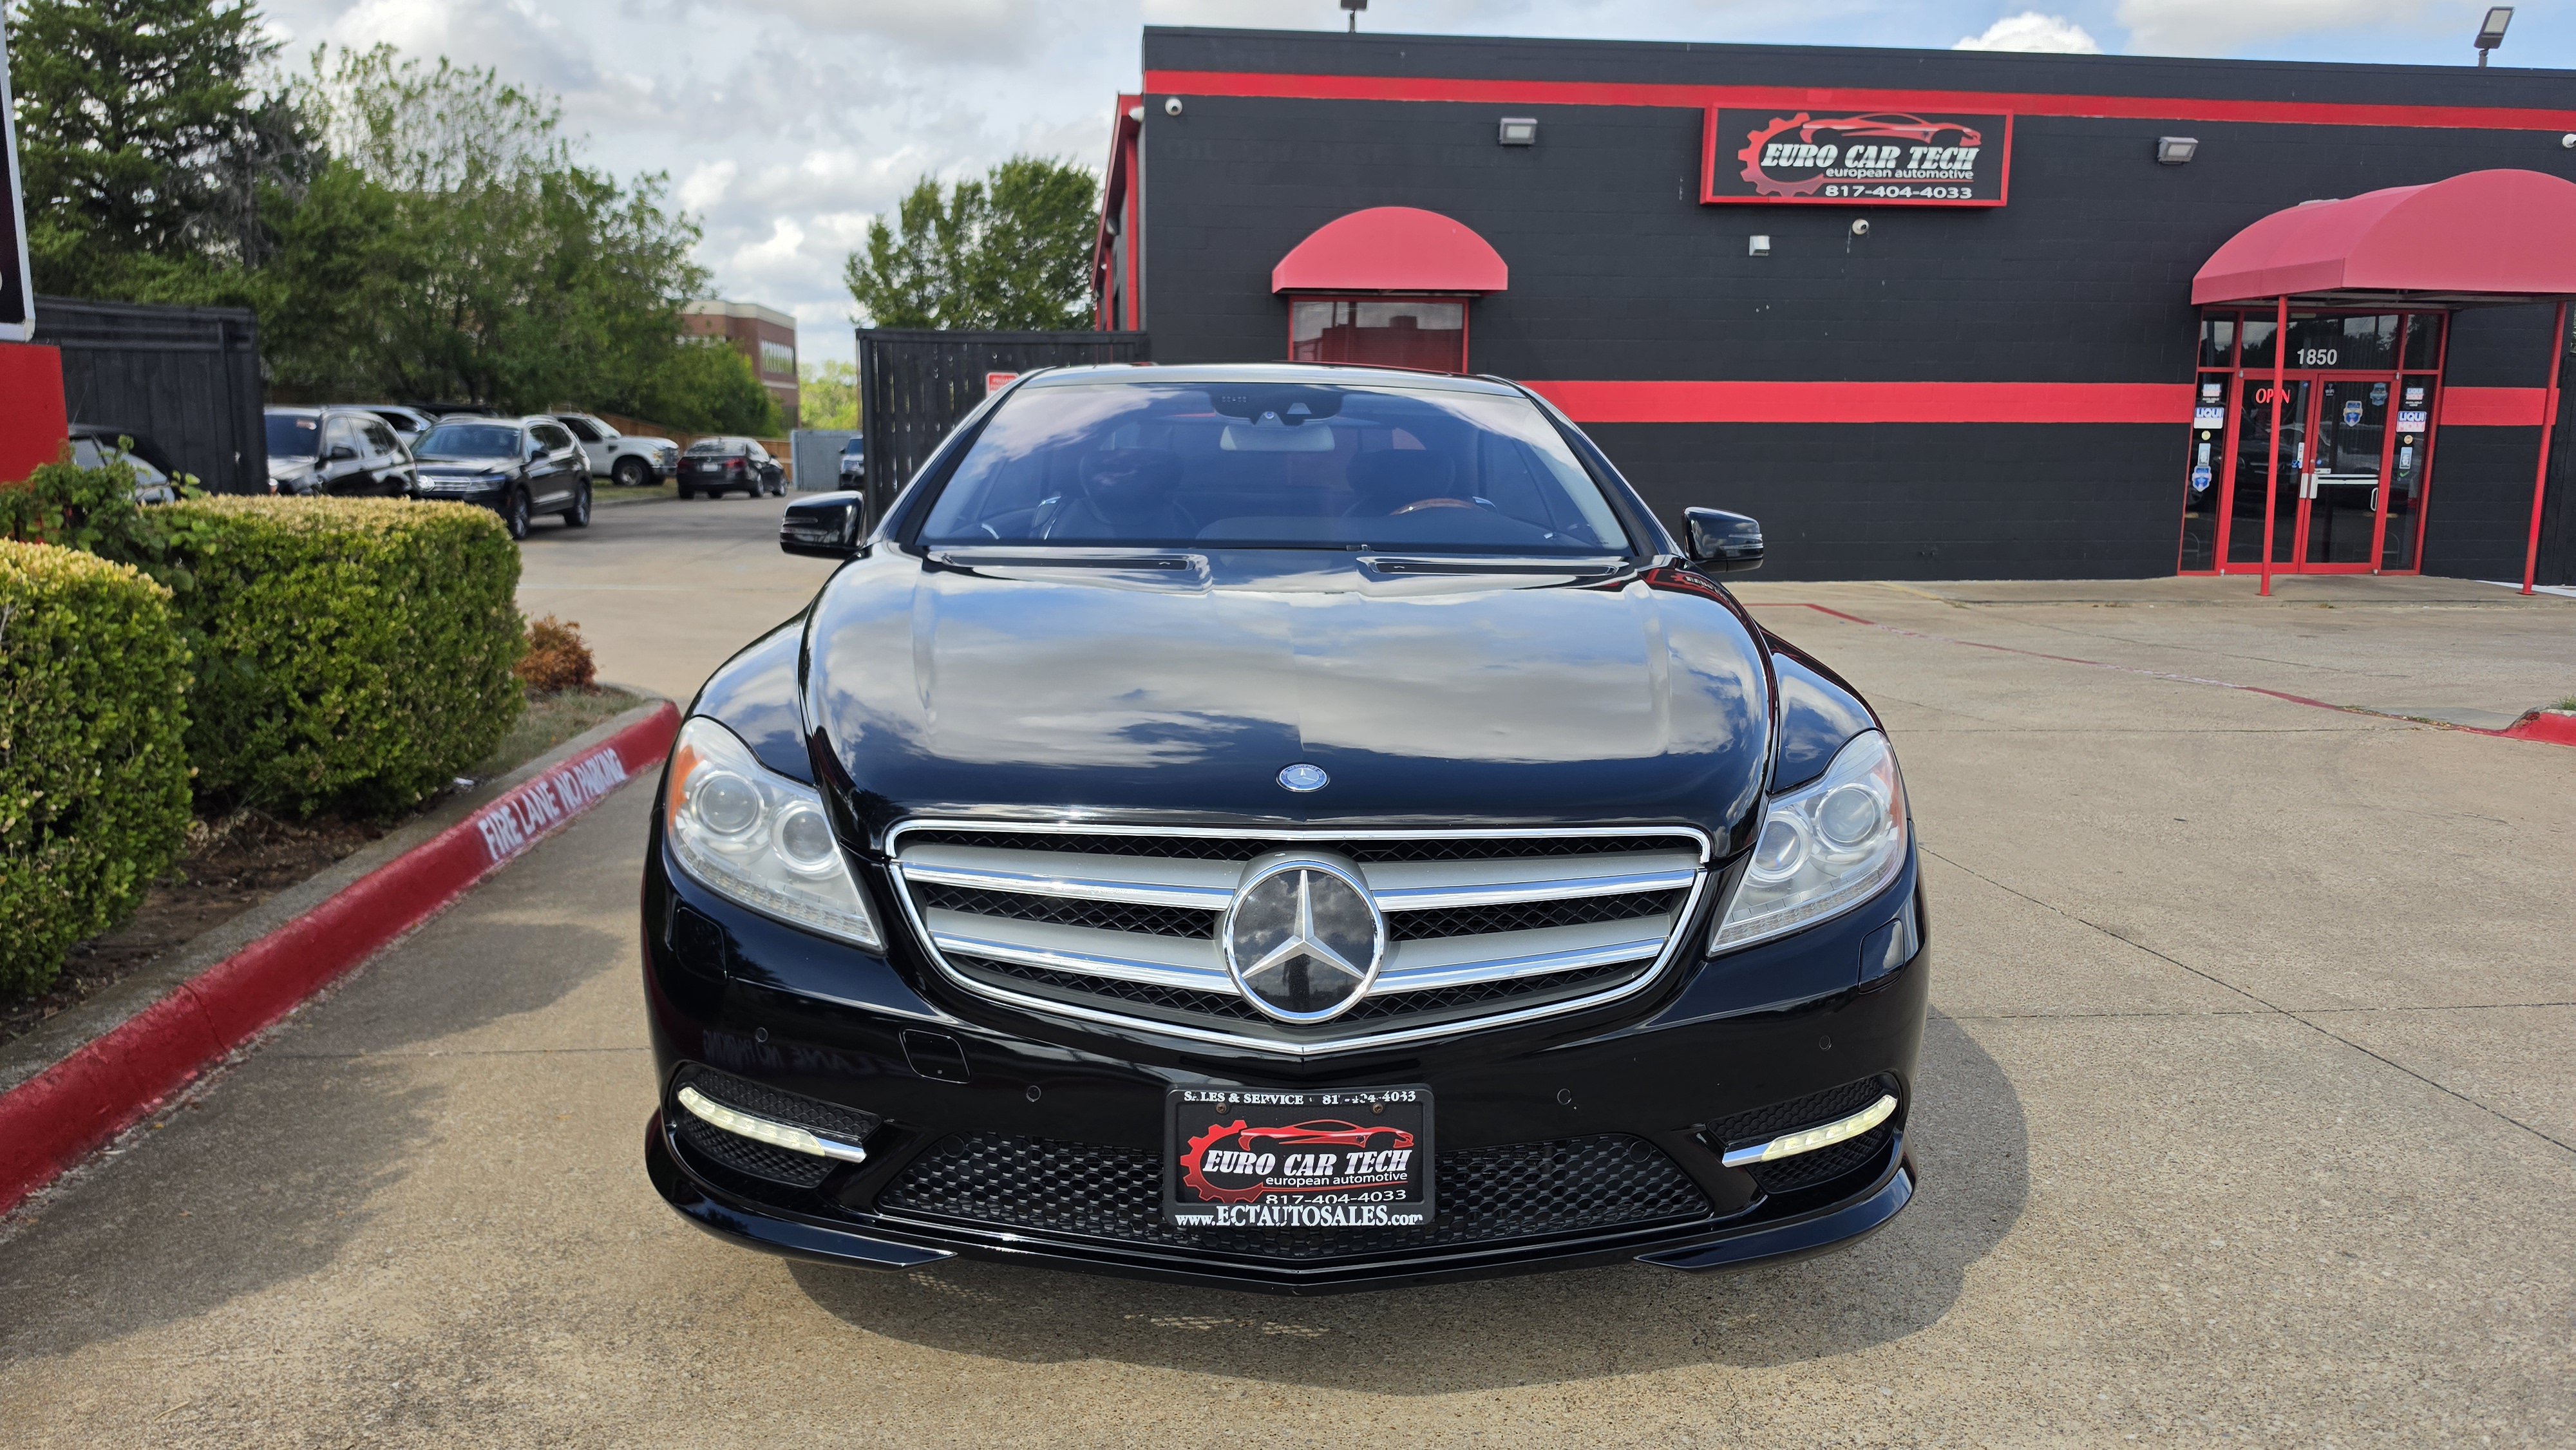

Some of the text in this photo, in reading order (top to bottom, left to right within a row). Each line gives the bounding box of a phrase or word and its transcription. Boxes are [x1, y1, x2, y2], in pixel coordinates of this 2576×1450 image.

[1761, 144, 1980, 170] EURO CAR TECH
[1826, 168, 1975, 180] european automotive
[1825, 185, 1973, 199] 817-404-4033
[2297, 348, 2337, 365] 1850
[2256, 388, 2291, 404] OPN
[2196, 408, 2223, 419] LIQUI
[2399, 412, 2425, 422] LIQUI
[477, 747, 630, 862] FIRE LANE NO PARKING
[1228, 1093, 1240, 1103] &
[1244, 1093, 1304, 1105] SERVICE
[1203, 1149, 1413, 1176] EURO CAR TECH
[1265, 1172, 1408, 1188] european automotive
[1265, 1189, 1406, 1205] 817-404-4033
